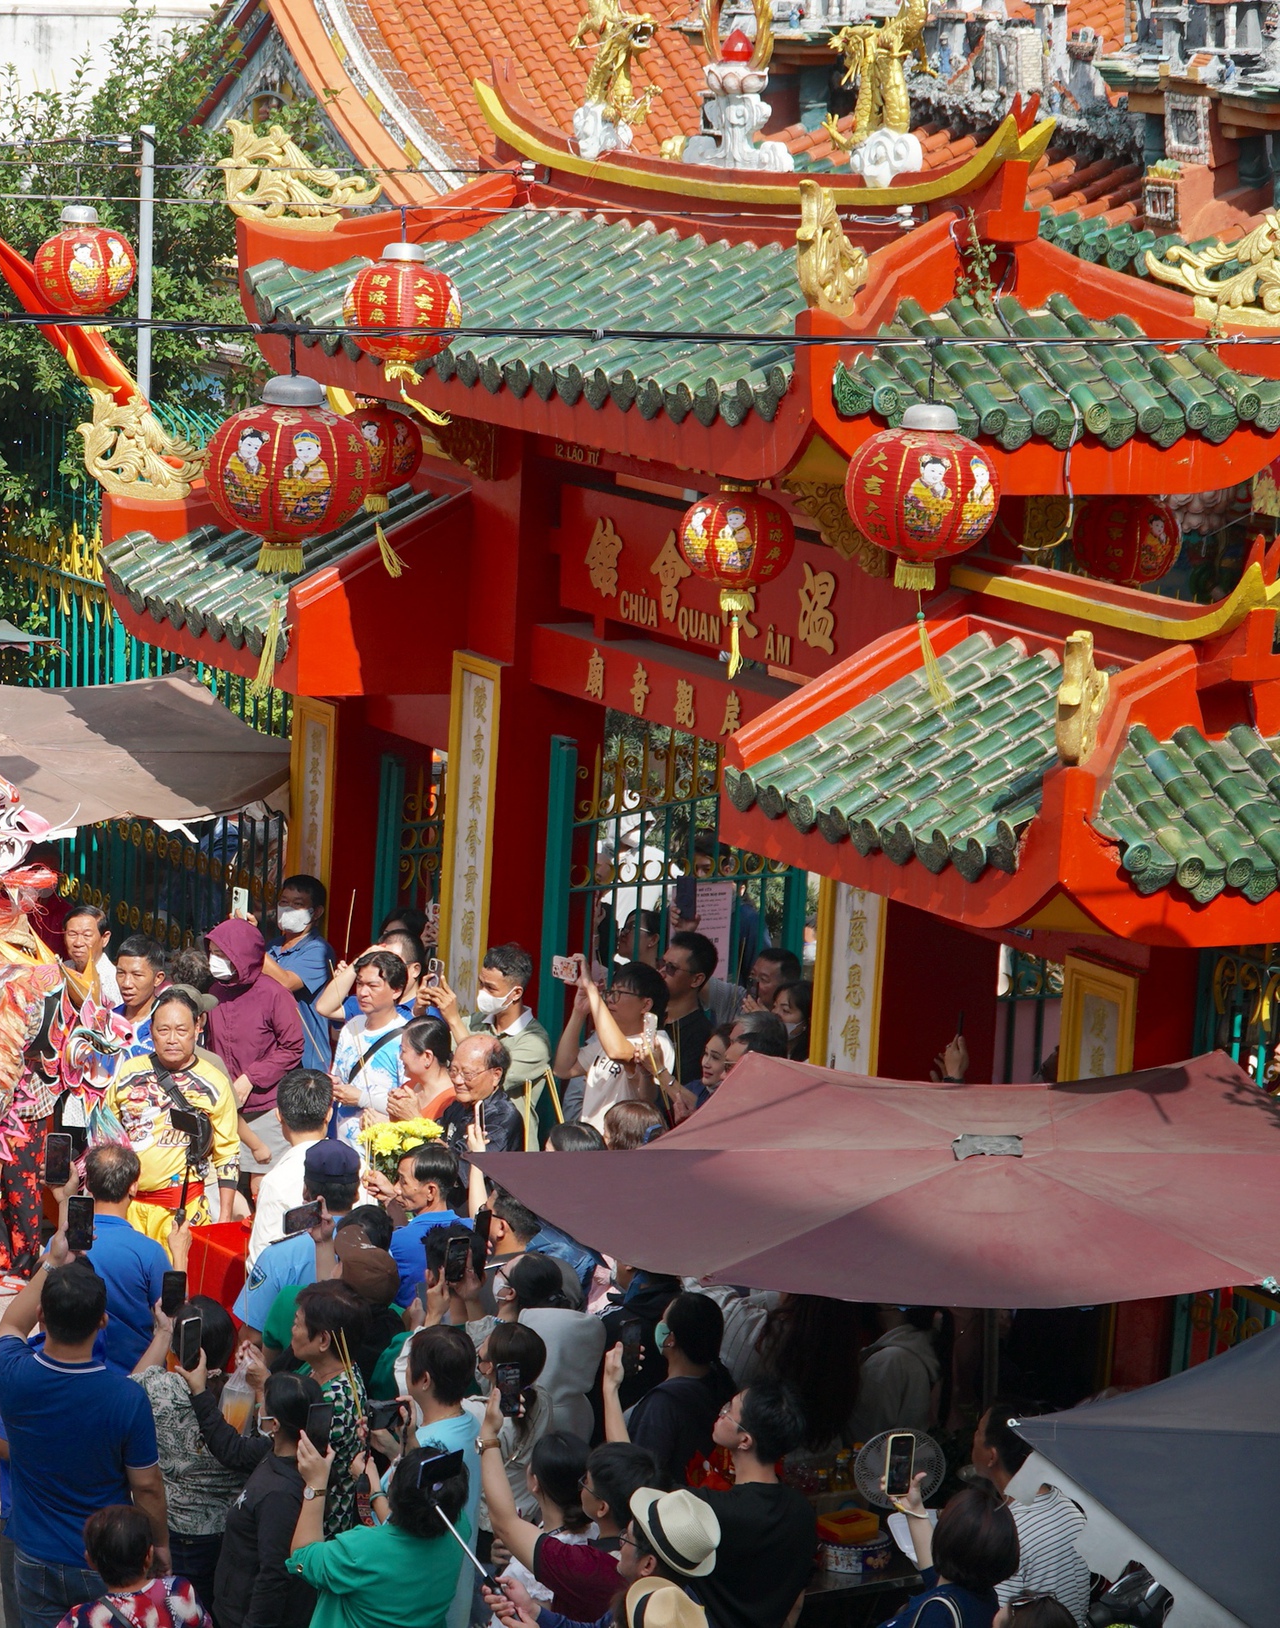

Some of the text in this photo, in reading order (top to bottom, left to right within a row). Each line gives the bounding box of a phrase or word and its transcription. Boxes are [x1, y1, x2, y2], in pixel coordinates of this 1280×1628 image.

[862, 446, 890, 540] 大吉大利
[620, 589, 791, 666] CHÙA QUAN ÂM
